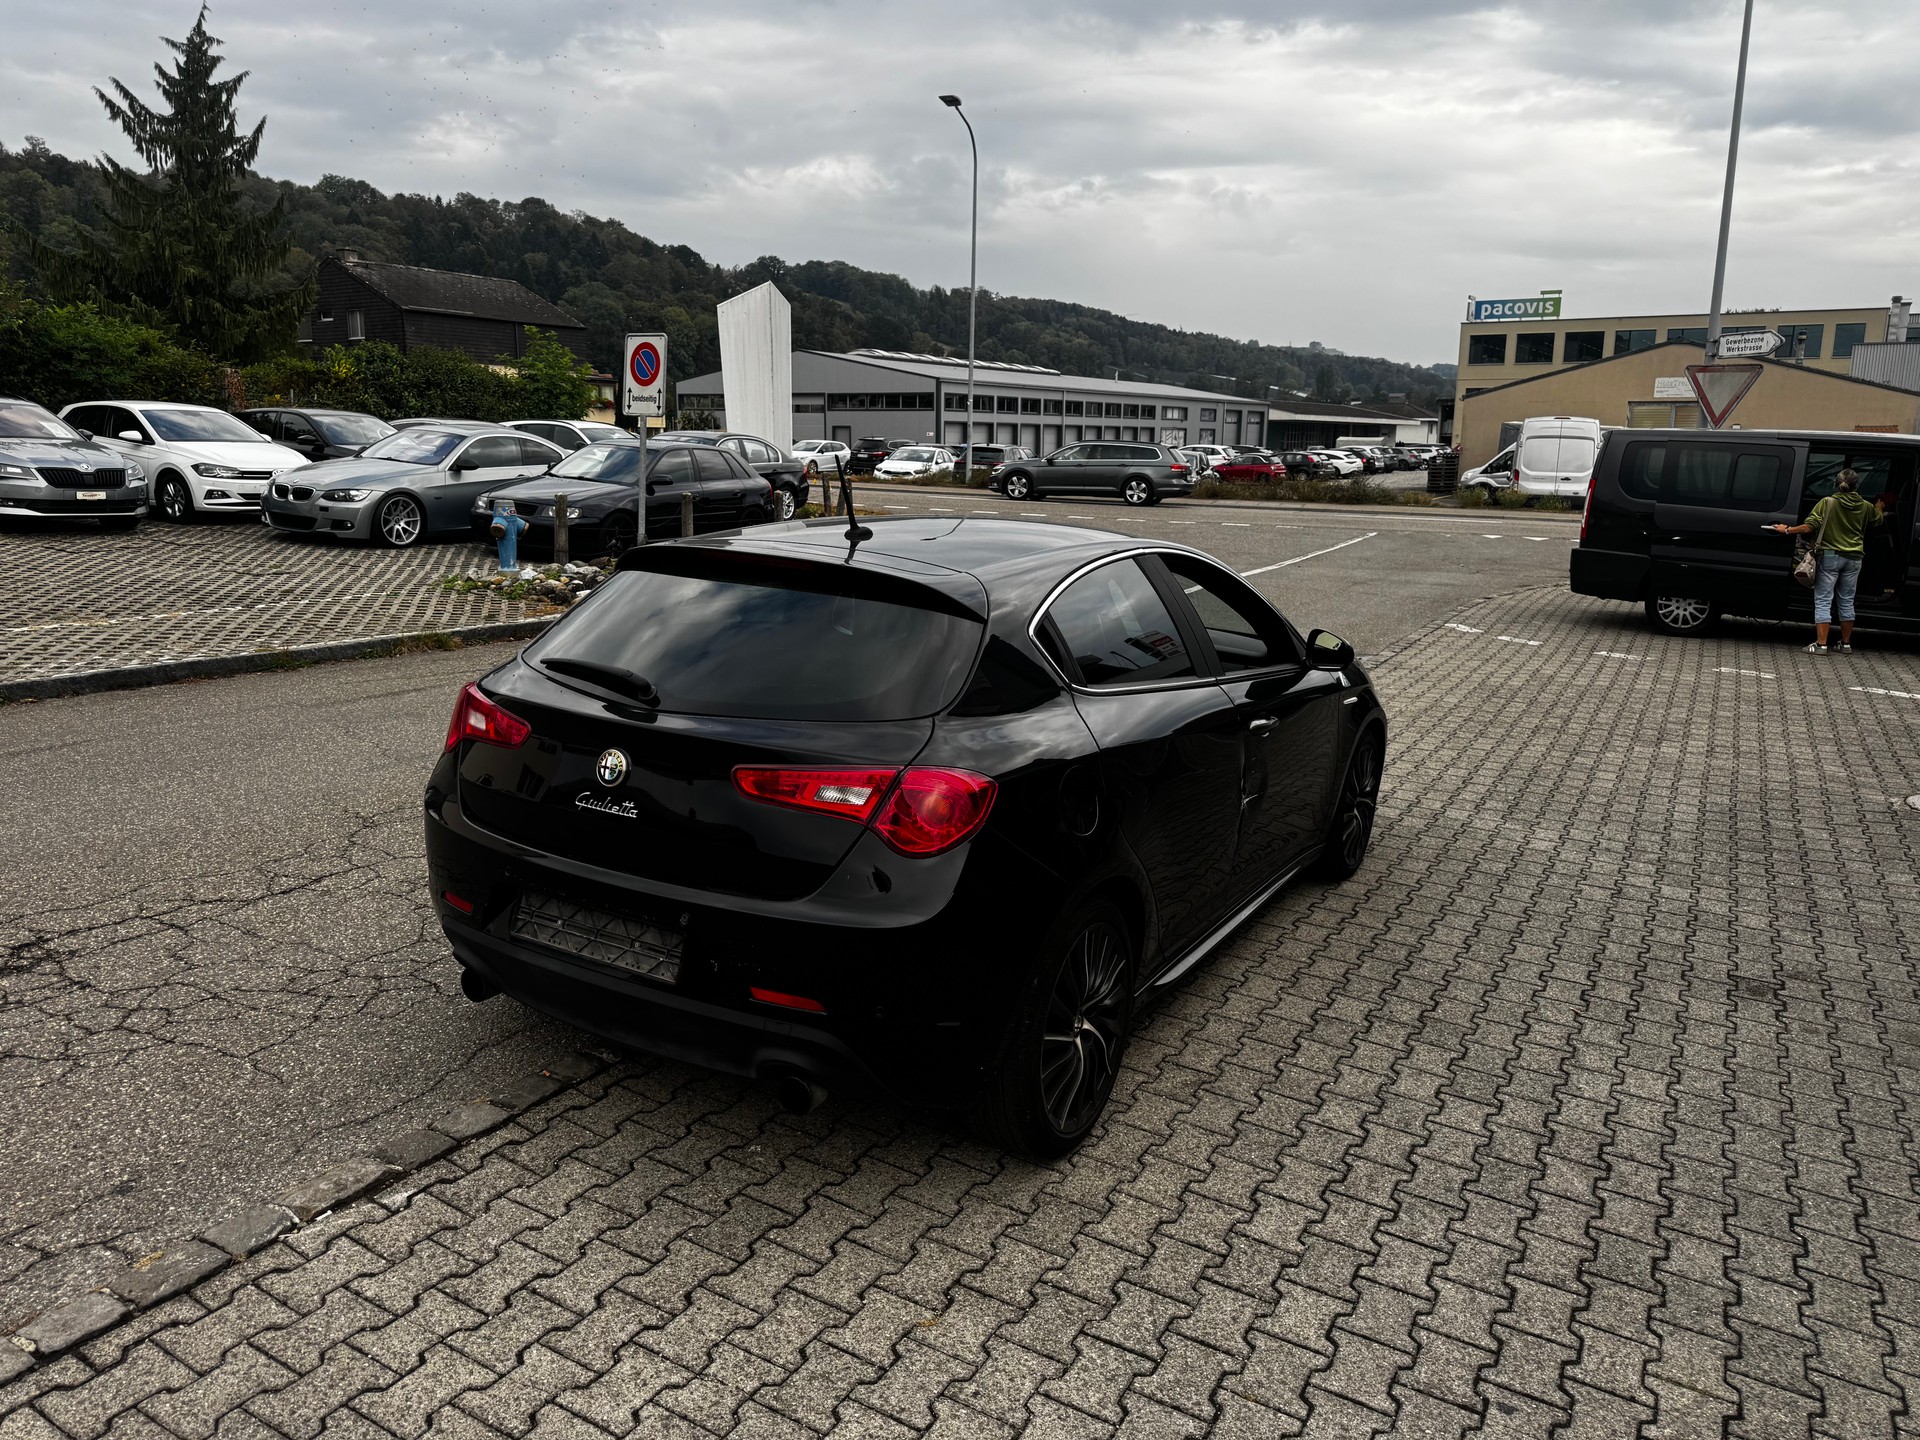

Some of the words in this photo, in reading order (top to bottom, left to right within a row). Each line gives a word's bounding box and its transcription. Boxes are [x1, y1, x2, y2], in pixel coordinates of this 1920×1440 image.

[1480, 301, 1554, 320] pacovis
[1725, 336, 1765, 346] Gewerbezone
[1726, 344, 1763, 353] Werkstrasse
[632, 394, 657, 404] beidseitig
[575, 792, 638, 818] Giulietta
